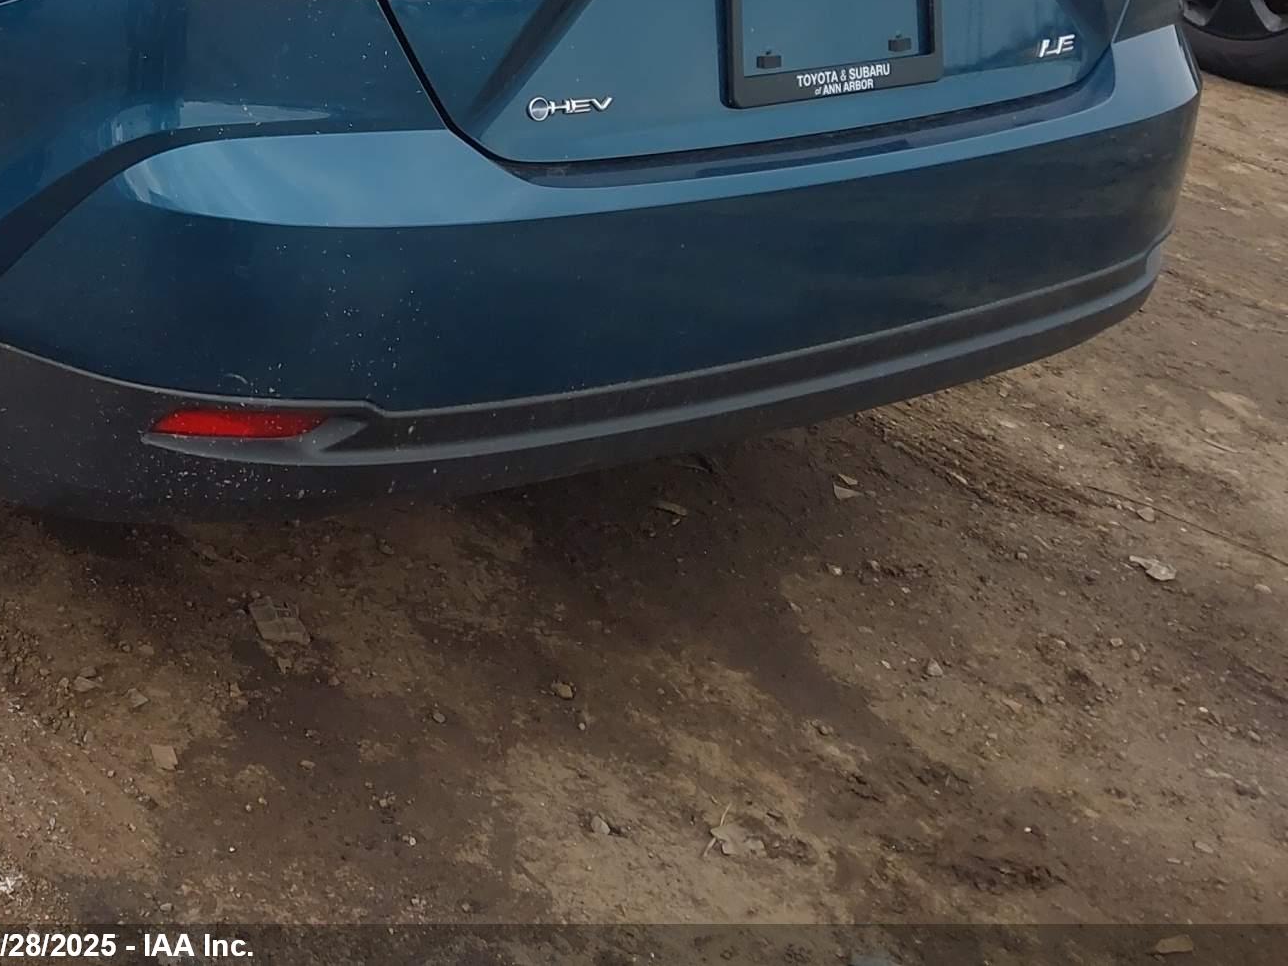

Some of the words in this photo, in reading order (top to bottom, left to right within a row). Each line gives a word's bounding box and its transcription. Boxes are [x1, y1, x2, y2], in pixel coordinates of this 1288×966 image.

[1038, 34, 1076, 58] LE
[796, 69, 839, 87] TOYOTA
[839, 68, 848, 81] &
[848, 62, 890, 80] SUBARU
[814, 86, 822, 95] of
[822, 82, 842, 95] ANN
[843, 78, 874, 92] ARBOR
